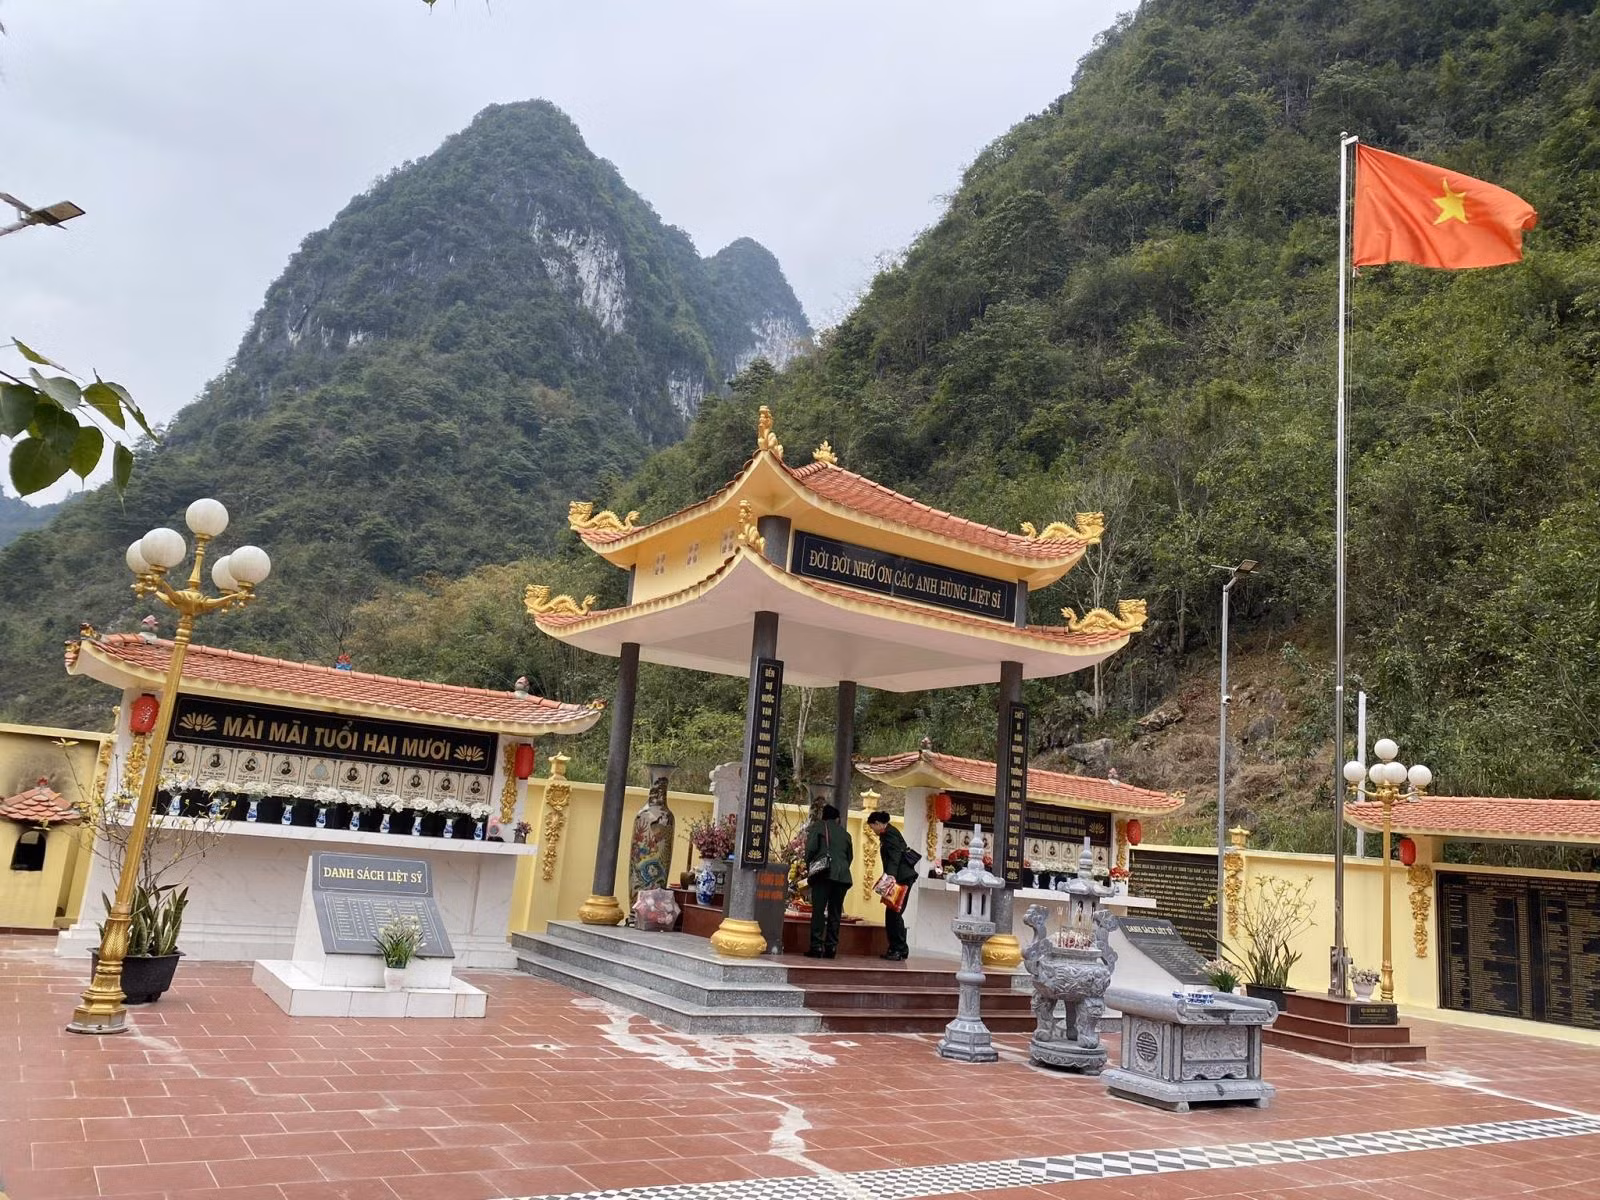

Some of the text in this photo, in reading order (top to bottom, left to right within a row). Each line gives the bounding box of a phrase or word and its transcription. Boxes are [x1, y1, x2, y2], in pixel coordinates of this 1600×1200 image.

[809, 547, 829, 570] ĐỜI
[831, 551, 851, 575] ĐỜI
[852, 559, 876, 580] NHỚ
[877, 565, 893, 585] ƠN
[894, 567, 915, 589] CÁC
[915, 576, 938, 594] ANH
[939, 577, 967, 600] HÙNG
[969, 584, 990, 608] LIỆT
[222, 714, 451, 761] MÃI MÃI TUỔI HAI MƯƠI
[323, 866, 354, 879] DANH
[356, 866, 385, 881] SÁCH
[387, 869, 409, 884] LIỆT
